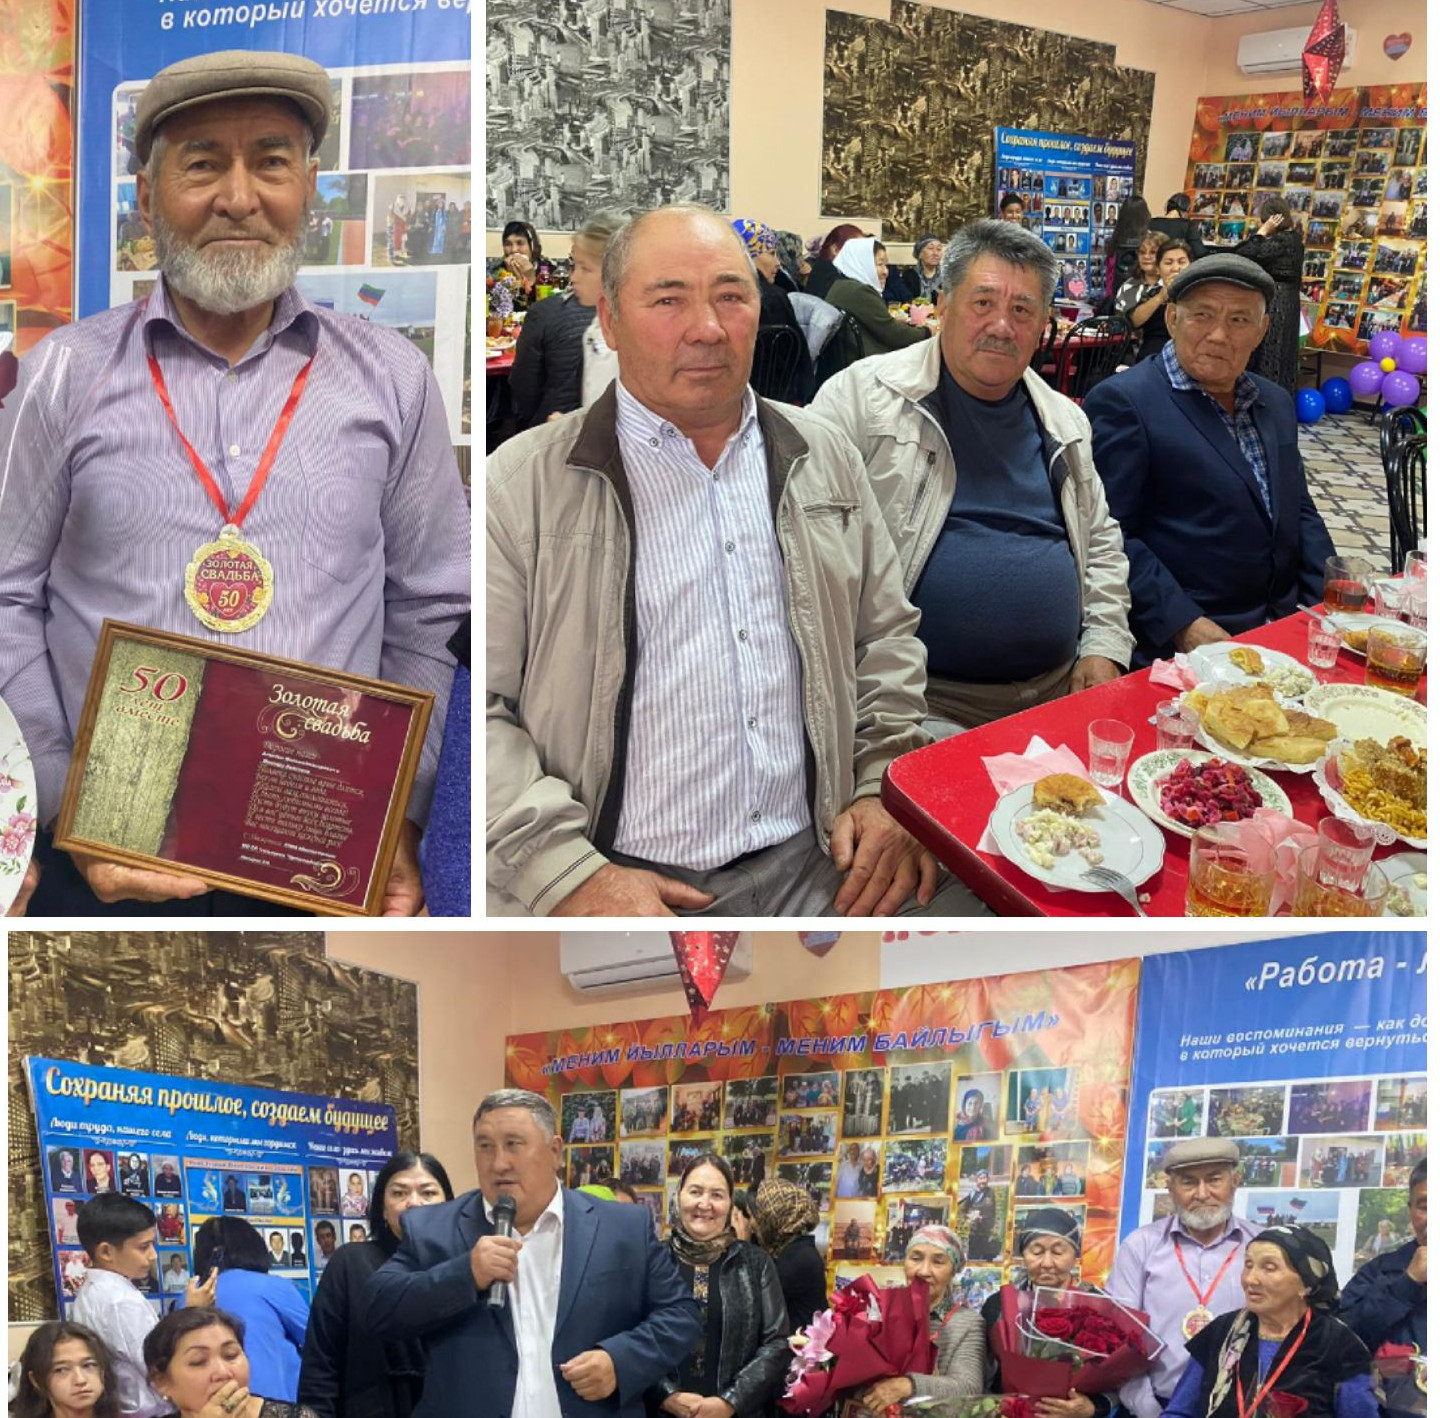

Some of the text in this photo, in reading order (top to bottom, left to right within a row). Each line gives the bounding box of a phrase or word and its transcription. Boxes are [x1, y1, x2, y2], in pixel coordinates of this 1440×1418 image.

[160, 15, 174, 30] в
[183, 1, 304, 28] который
[201, 568, 259, 582] СВАДЬБА
[206, 560, 254, 570] ЗОЛОТАЯ
[218, 589, 240, 608] 50
[119, 665, 188, 702] 50
[268, 683, 351, 718] Золотая
[304, 716, 372, 744] свадьба
[1244, 956, 1385, 992] «Работа
[540, 1048, 621, 1076] «МЕНИМ
[626, 1039, 757, 1061] ЙЫЛЛАРЫМ
[774, 1034, 867, 1056] МЕНИМ
[873, 1010, 1061, 1052] БАЙЛЫГЫМ»
[1179, 1033, 1222, 1048] Наши
[1226, 1022, 1344, 1043] воспоминания
[1376, 1018, 1406, 1032] как
[1180, 1050, 1188, 1061] в
[1192, 1041, 1264, 1061] который
[1269, 1036, 1339, 1055] хочется
[45, 1066, 389, 1135] Сохраняя прошлое, создаем будущее
